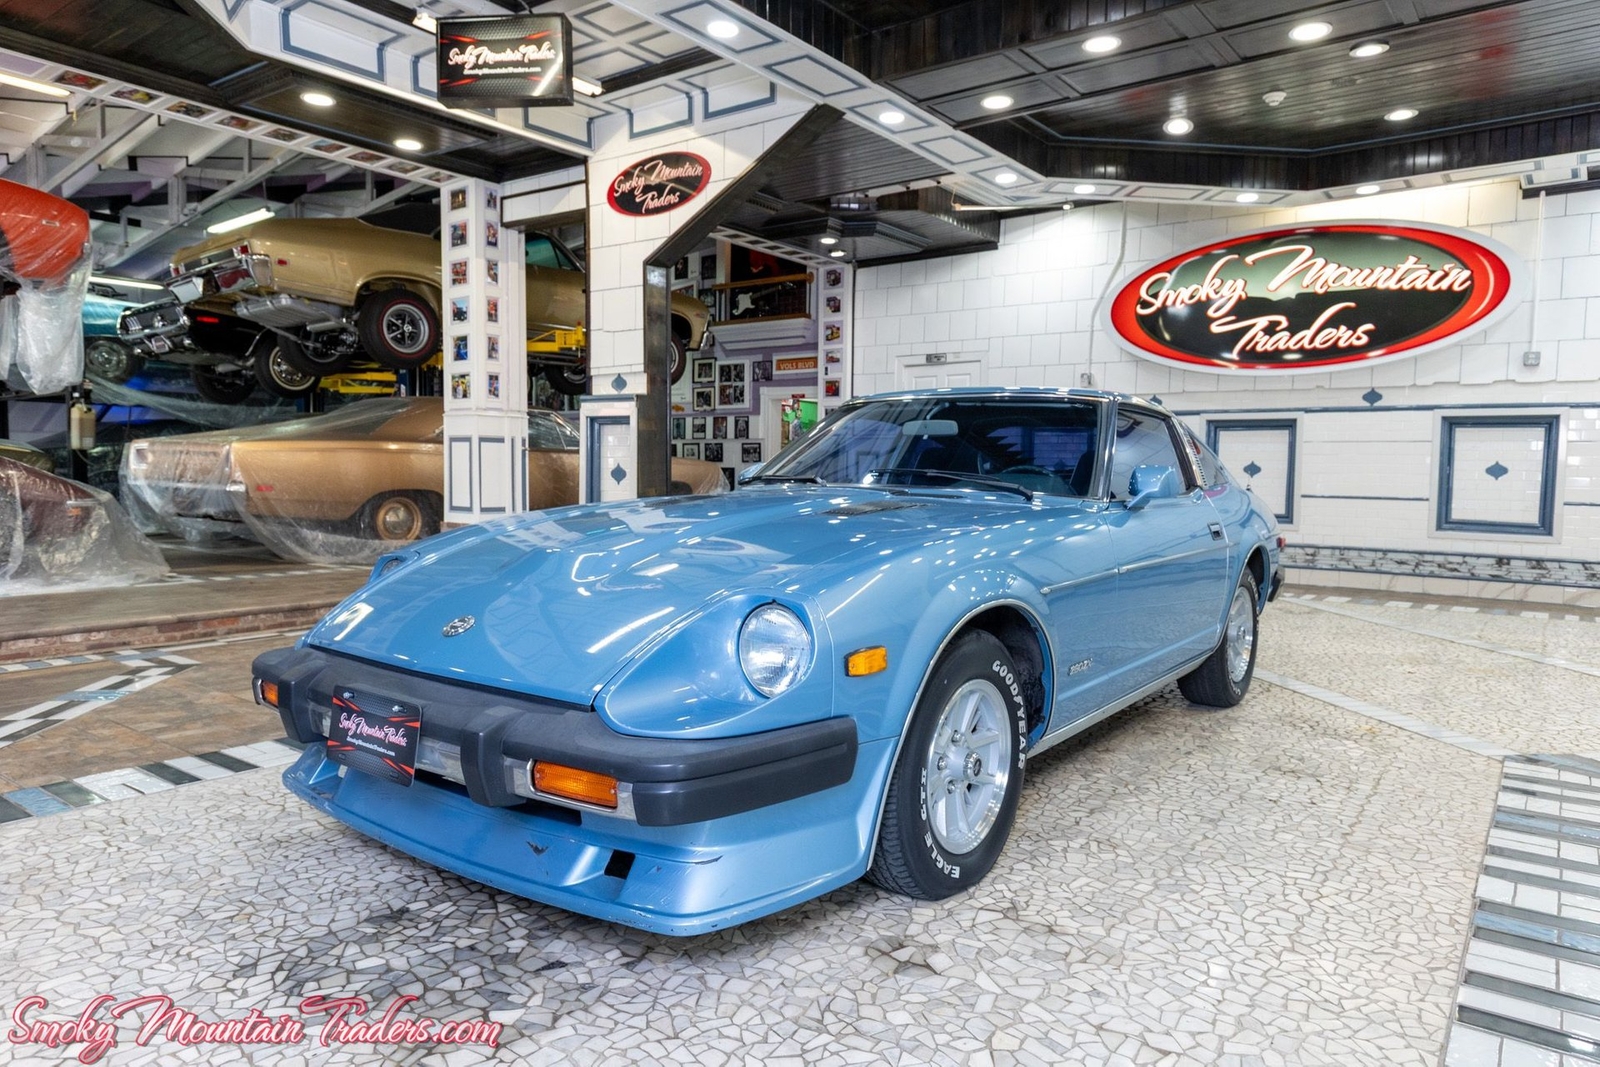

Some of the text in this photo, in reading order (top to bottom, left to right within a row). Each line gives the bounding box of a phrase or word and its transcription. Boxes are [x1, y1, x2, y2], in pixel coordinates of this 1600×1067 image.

[613, 159, 703, 197] Smoky Mountain
[635, 182, 681, 214] Traders
[1136, 245, 1473, 318] Smoky Mountain
[1210, 302, 1376, 361] Traders
[924, 831, 960, 879] EAGLE
